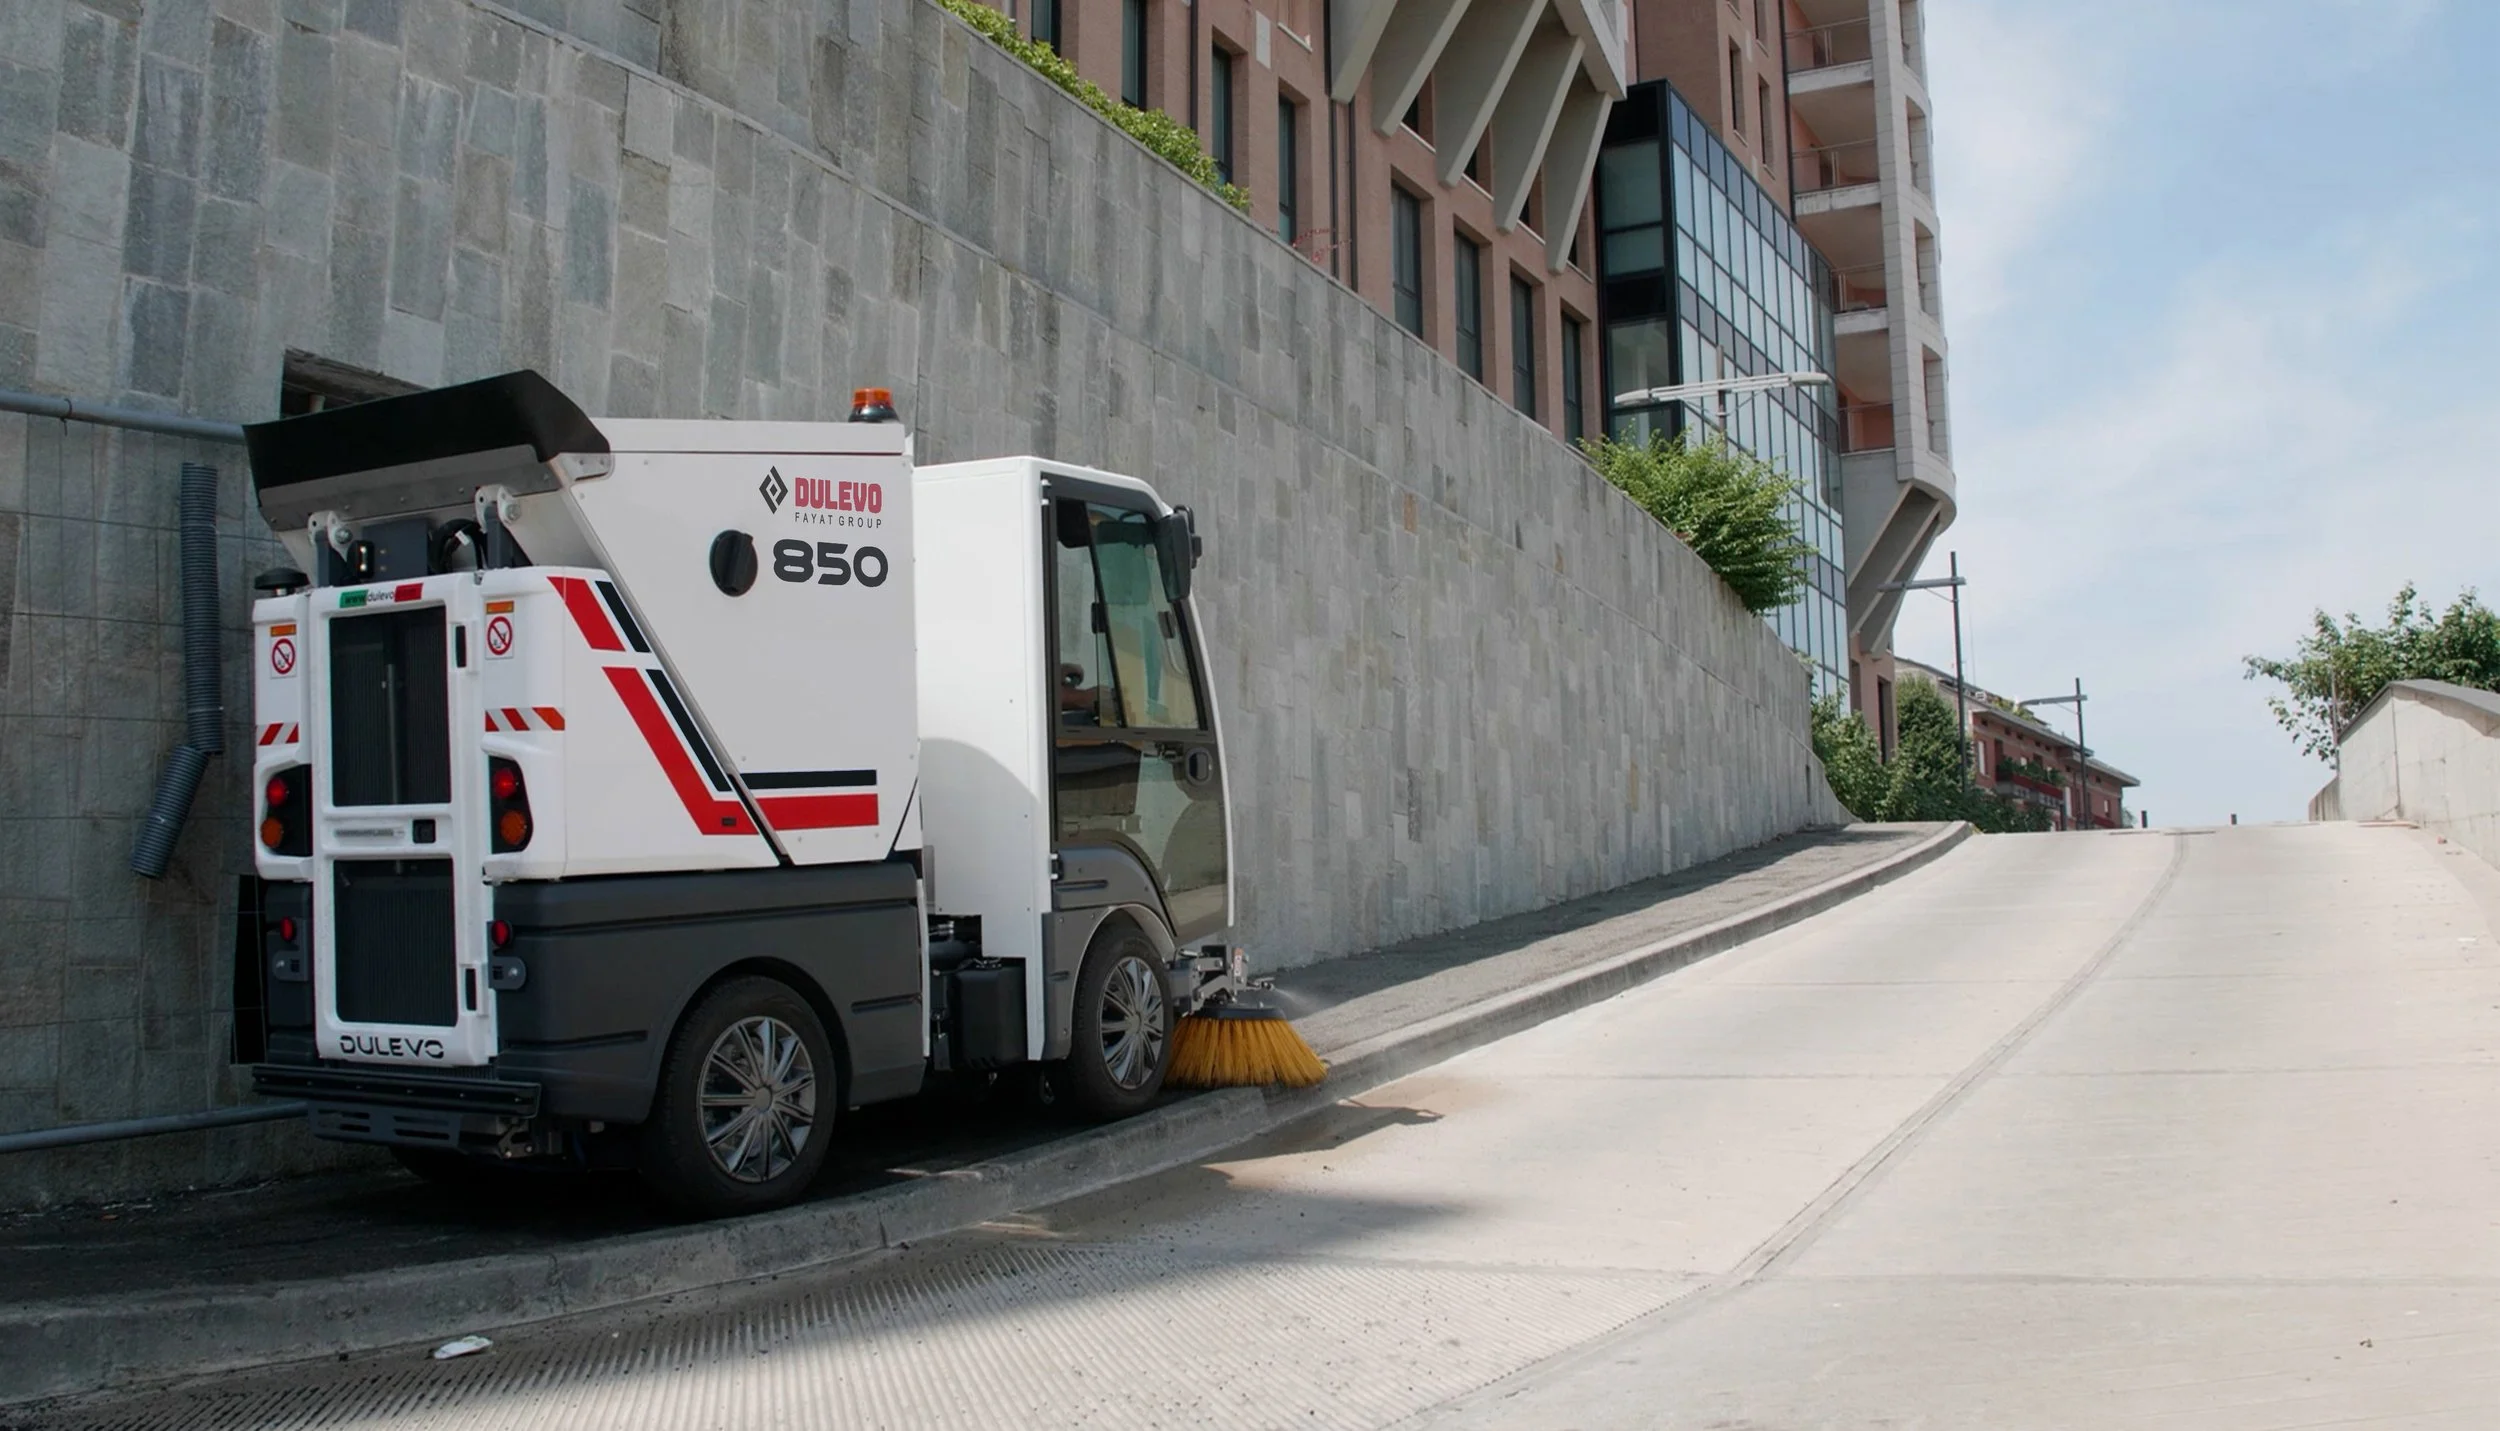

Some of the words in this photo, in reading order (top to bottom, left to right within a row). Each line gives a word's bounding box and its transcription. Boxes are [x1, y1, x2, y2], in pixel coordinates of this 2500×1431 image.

[795, 477, 882, 514] DULEVO
[795, 512, 833, 525] FAYAT
[839, 516, 882, 529] GROUP
[773, 539, 889, 588] 850
[340, 1035, 444, 1059] DULEVO
